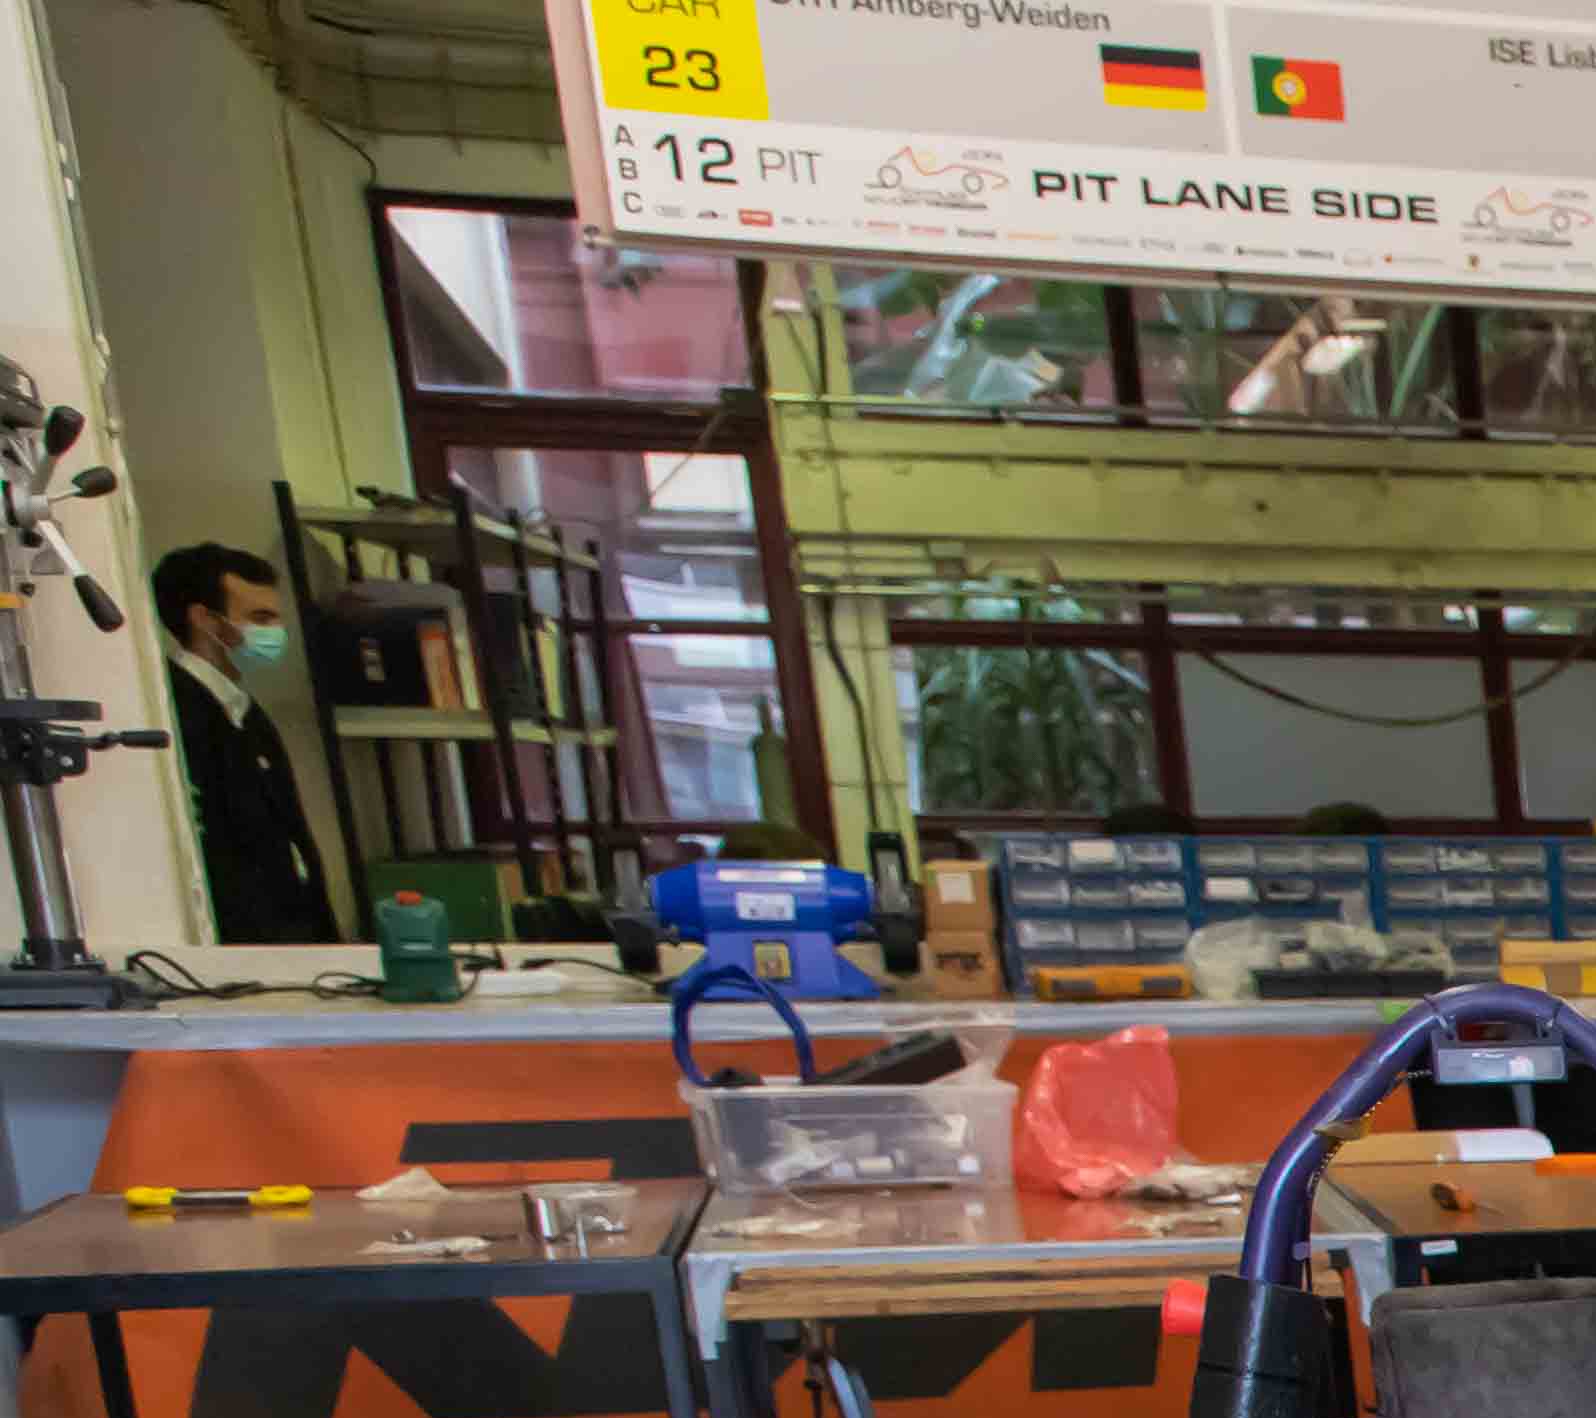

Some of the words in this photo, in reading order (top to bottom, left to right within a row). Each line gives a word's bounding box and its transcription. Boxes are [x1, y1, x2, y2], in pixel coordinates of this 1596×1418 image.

[642, 45, 721, 92] 23
[614, 123, 635, 148] A
[617, 157, 639, 181] B
[652, 133, 740, 185] 12
[756, 146, 824, 185] PIT
[621, 191, 644, 215] C
[1031, 169, 1118, 202] PIT
[1139, 176, 1291, 214] LANE
[1313, 188, 1440, 225] SIDE
